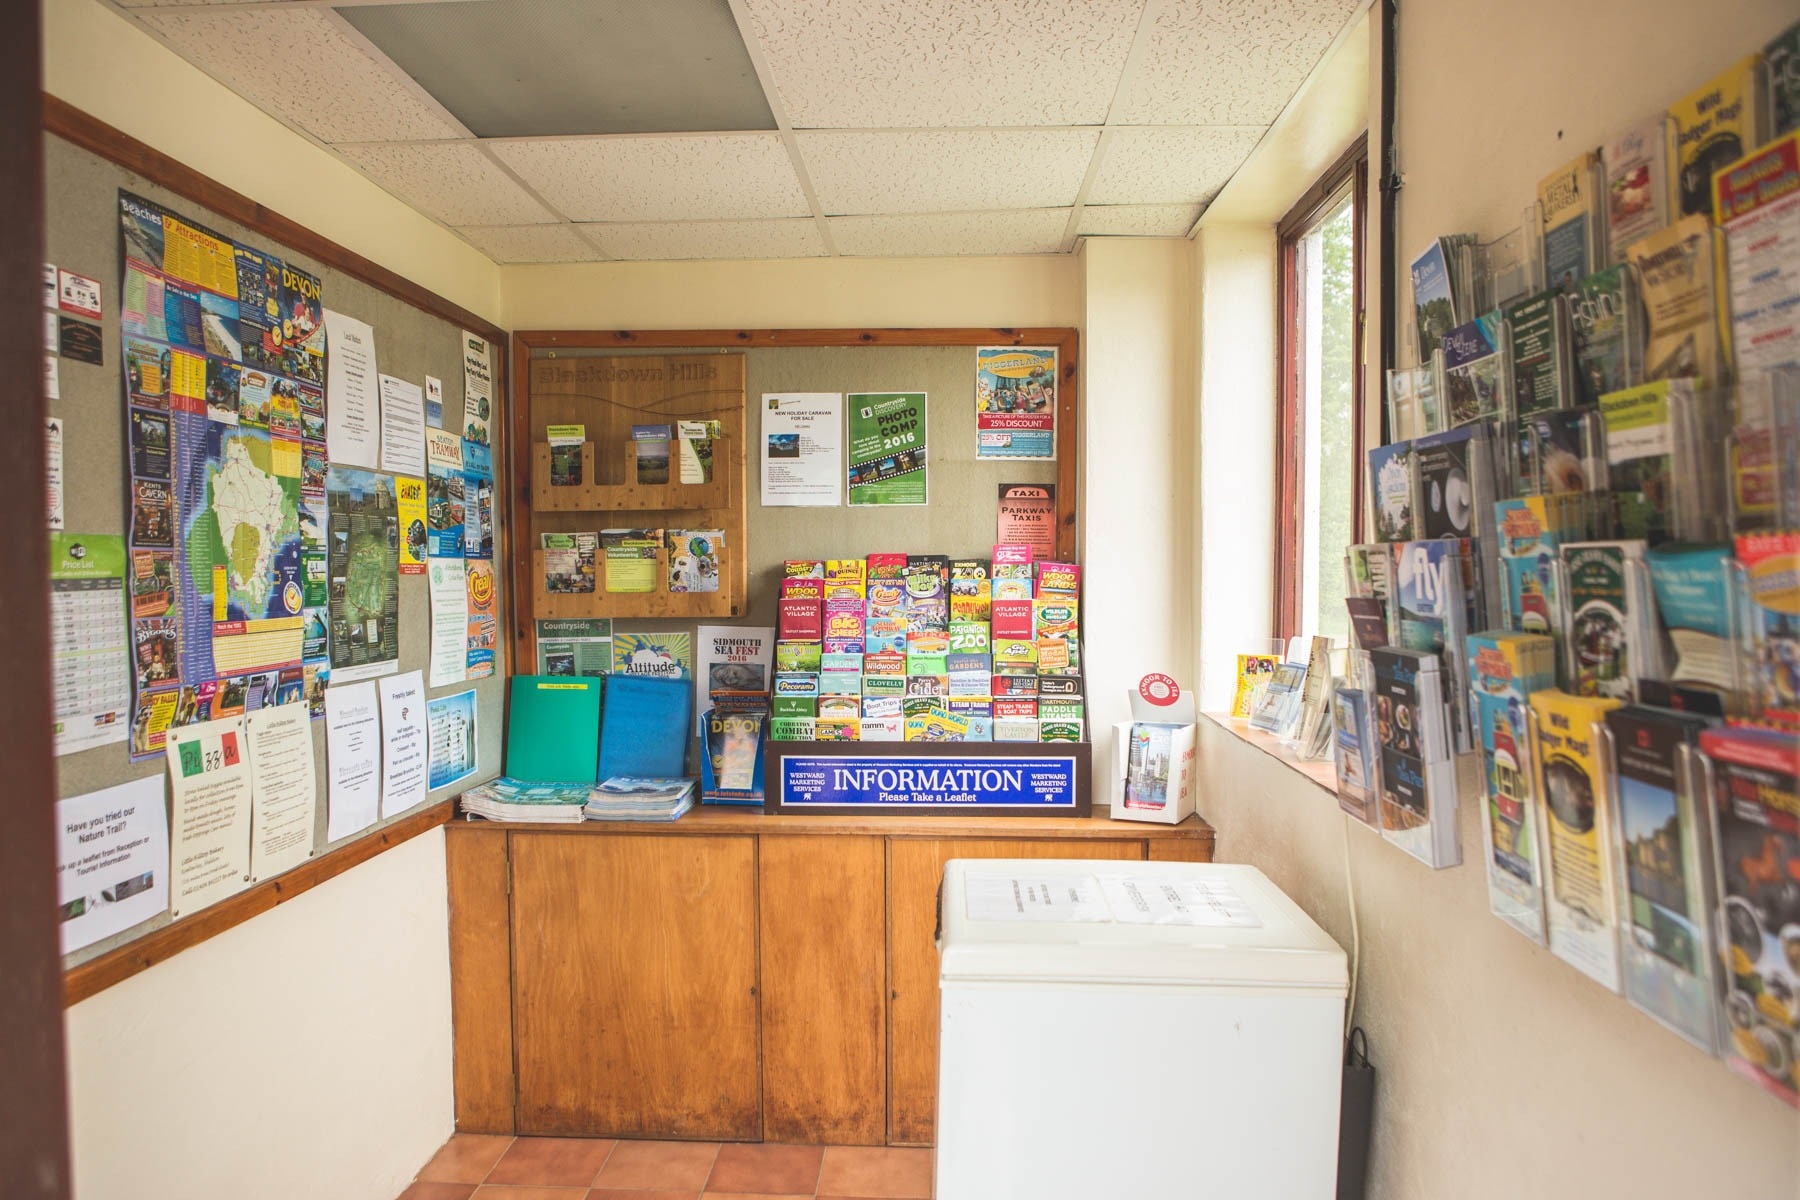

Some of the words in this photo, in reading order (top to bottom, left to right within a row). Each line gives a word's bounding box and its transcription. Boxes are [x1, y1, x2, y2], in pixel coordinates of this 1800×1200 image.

[122, 199, 162, 225] Beaches
[176, 225, 219, 250] Attractions
[282, 268, 321, 302] DEVON
[983, 357, 1047, 369] DIGGERLAND
[670, 363, 717, 381] Hills
[873, 397, 906, 410] Countryside
[877, 407, 918, 426] PHOTO
[881, 419, 918, 437] COMP
[883, 432, 915, 449] 2016
[430, 440, 460, 460] TRAMWAY
[139, 486, 167, 499] CAVERN
[1043, 572, 1074, 580] WOOD
[1040, 581, 1077, 589] LANDS
[543, 622, 590, 630] Countryside
[831, 618, 859, 629] BIG
[950, 625, 986, 634] PAIGNTON
[828, 629, 860, 637] SHEEP
[713, 638, 762, 647] SIDMOUTH
[950, 634, 987, 649] ZOO
[714, 646, 733, 655] SEA
[735, 647, 760, 656] FEST
[625, 661, 675, 674] Altitude
[780, 681, 814, 690] Pecorama
[1162, 676, 1172, 685] TO
[909, 683, 944, 695] Cider
[930, 708, 947, 718] QUAD
[948, 714, 969, 726] WORLD
[183, 745, 236, 772] Pizza
[833, 769, 1023, 791] INFORMATION
[879, 792, 909, 801] Please
[911, 792, 934, 801] Take
[944, 793, 976, 802] Leaflet
[66, 821, 88, 834] Have
[89, 817, 104, 830] you
[105, 810, 122, 822] tried
[123, 807, 135, 817] our
[78, 830, 105, 844] Nature
[106, 821, 127, 835] Trail?
[102, 849, 115, 858] from
[116, 839, 143, 853] Reception
[76, 863, 98, 877] Tourist
[99, 853, 131, 868] Information
